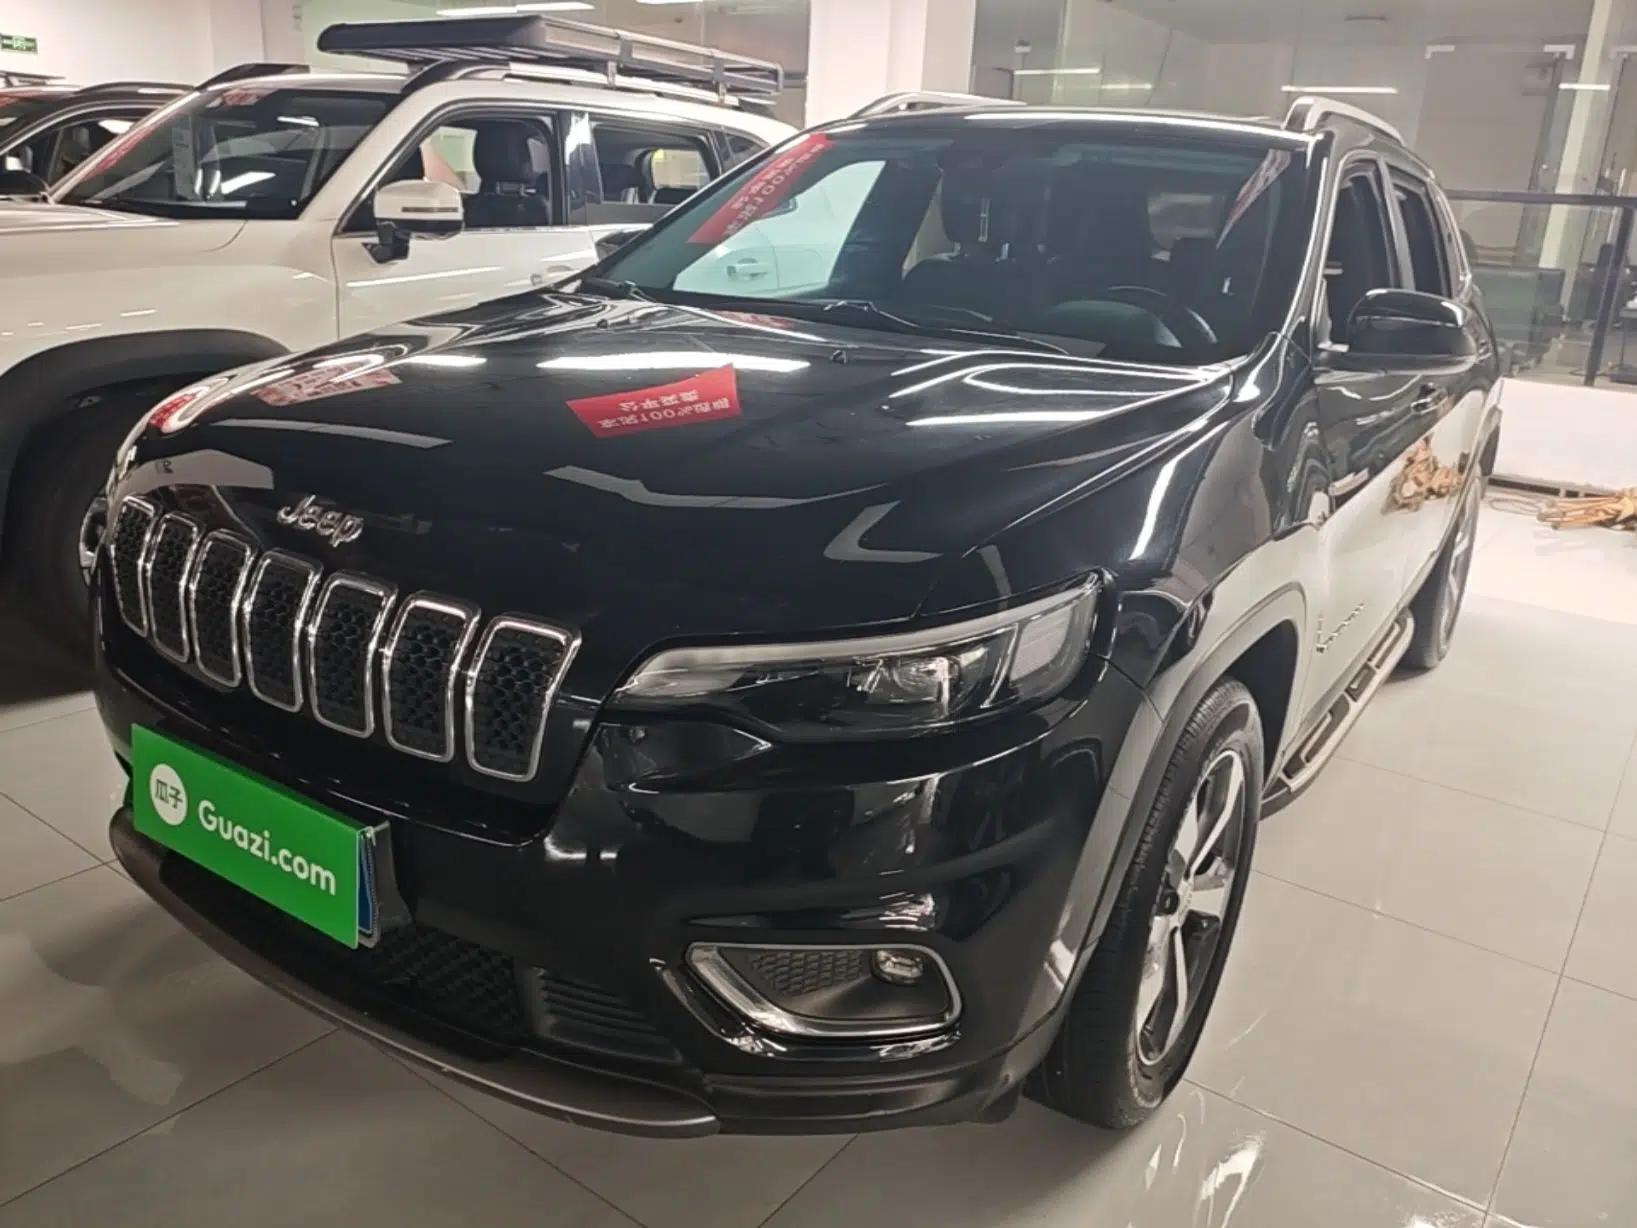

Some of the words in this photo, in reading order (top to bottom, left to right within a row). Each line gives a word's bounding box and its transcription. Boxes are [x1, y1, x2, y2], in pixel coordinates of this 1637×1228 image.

[277, 494, 364, 548] Jeep
[155, 778, 184, 809] 瓜子
[197, 799, 337, 896] Guazi.com
